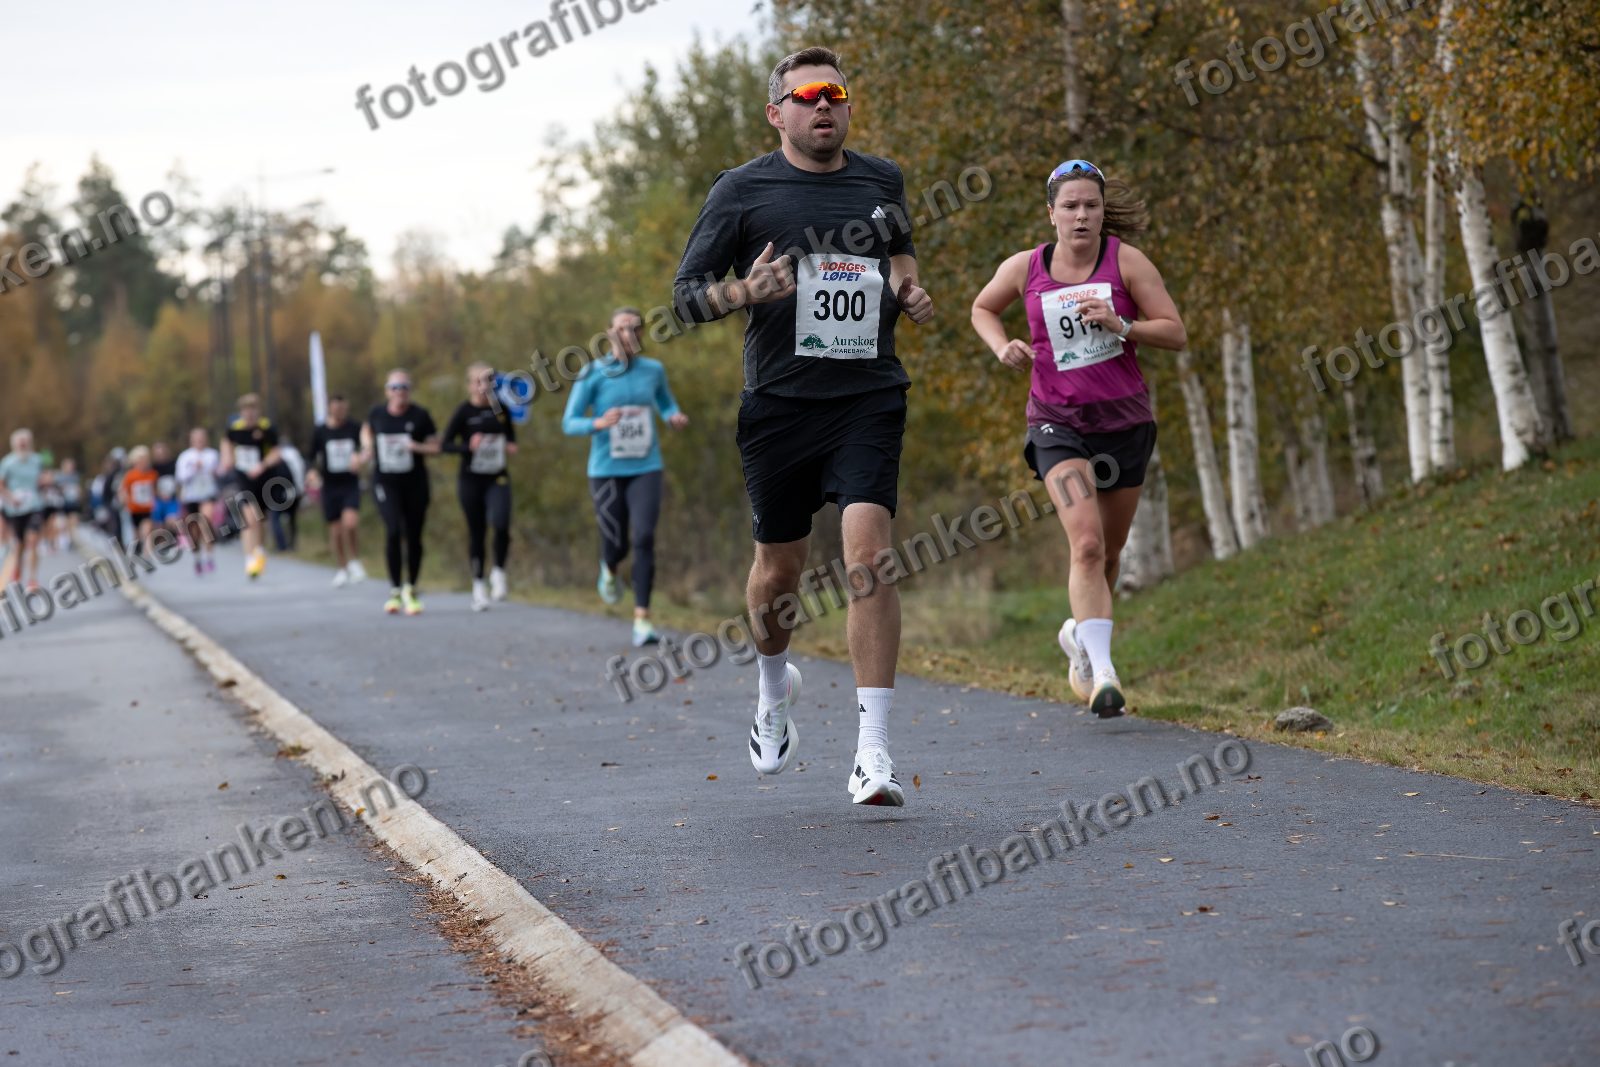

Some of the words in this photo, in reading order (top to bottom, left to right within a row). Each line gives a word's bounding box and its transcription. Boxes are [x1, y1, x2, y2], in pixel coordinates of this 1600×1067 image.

[818, 262, 867, 273] NORGES
[822, 271, 862, 282] LØPET
[813, 289, 866, 322] 300
[830, 335, 876, 348] Aurskog
